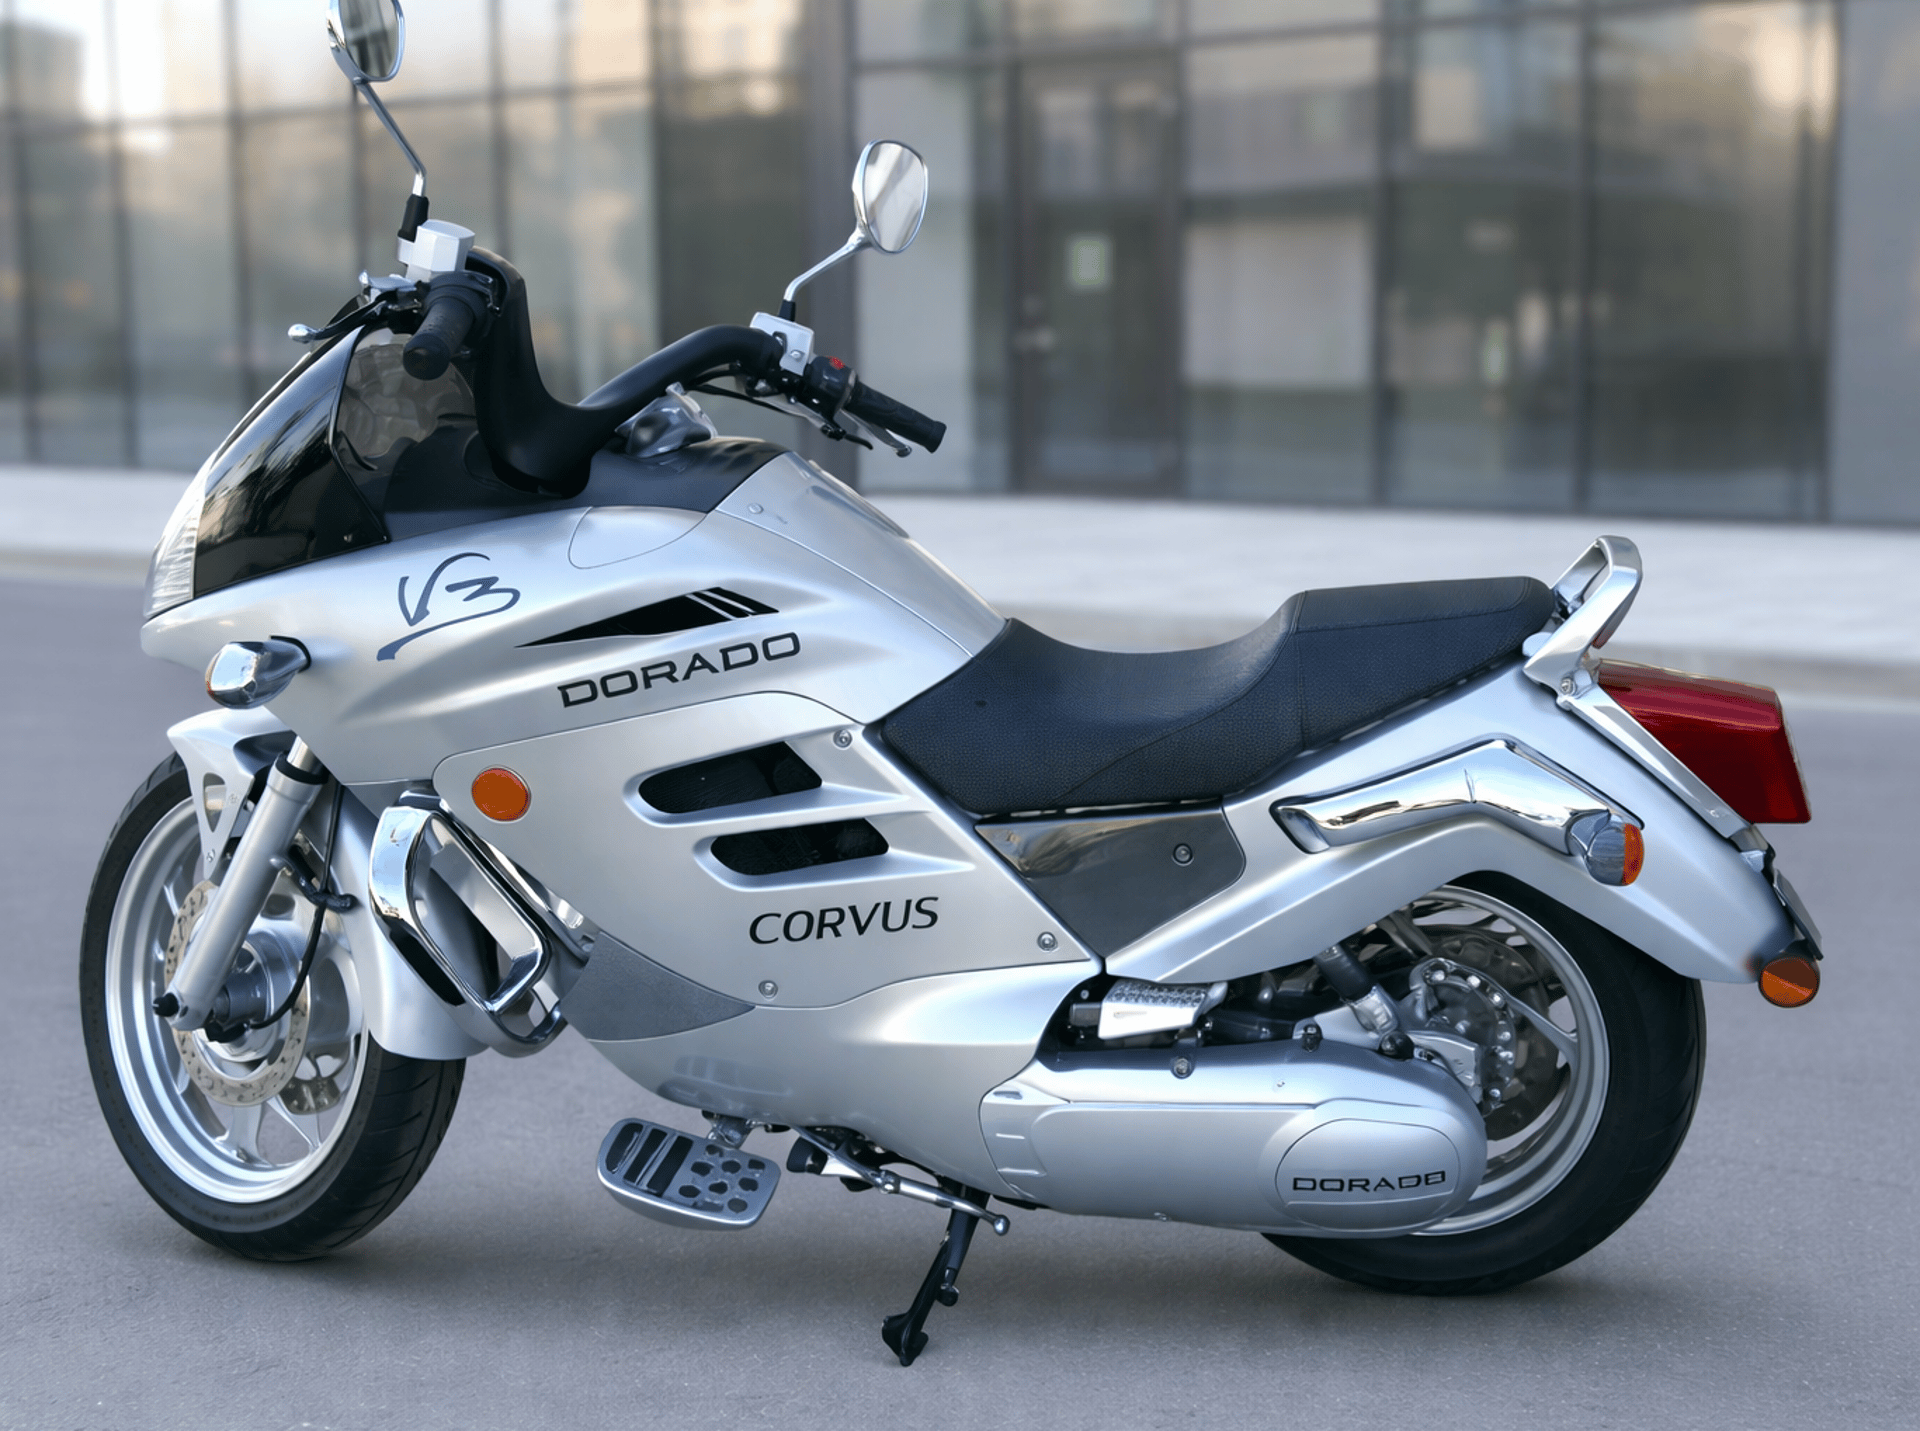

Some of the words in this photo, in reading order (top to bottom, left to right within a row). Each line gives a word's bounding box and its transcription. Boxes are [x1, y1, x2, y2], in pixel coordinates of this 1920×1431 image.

[376, 552, 521, 661] V3
[557, 631, 801, 708] DORADO
[749, 896, 939, 945] CORVUS
